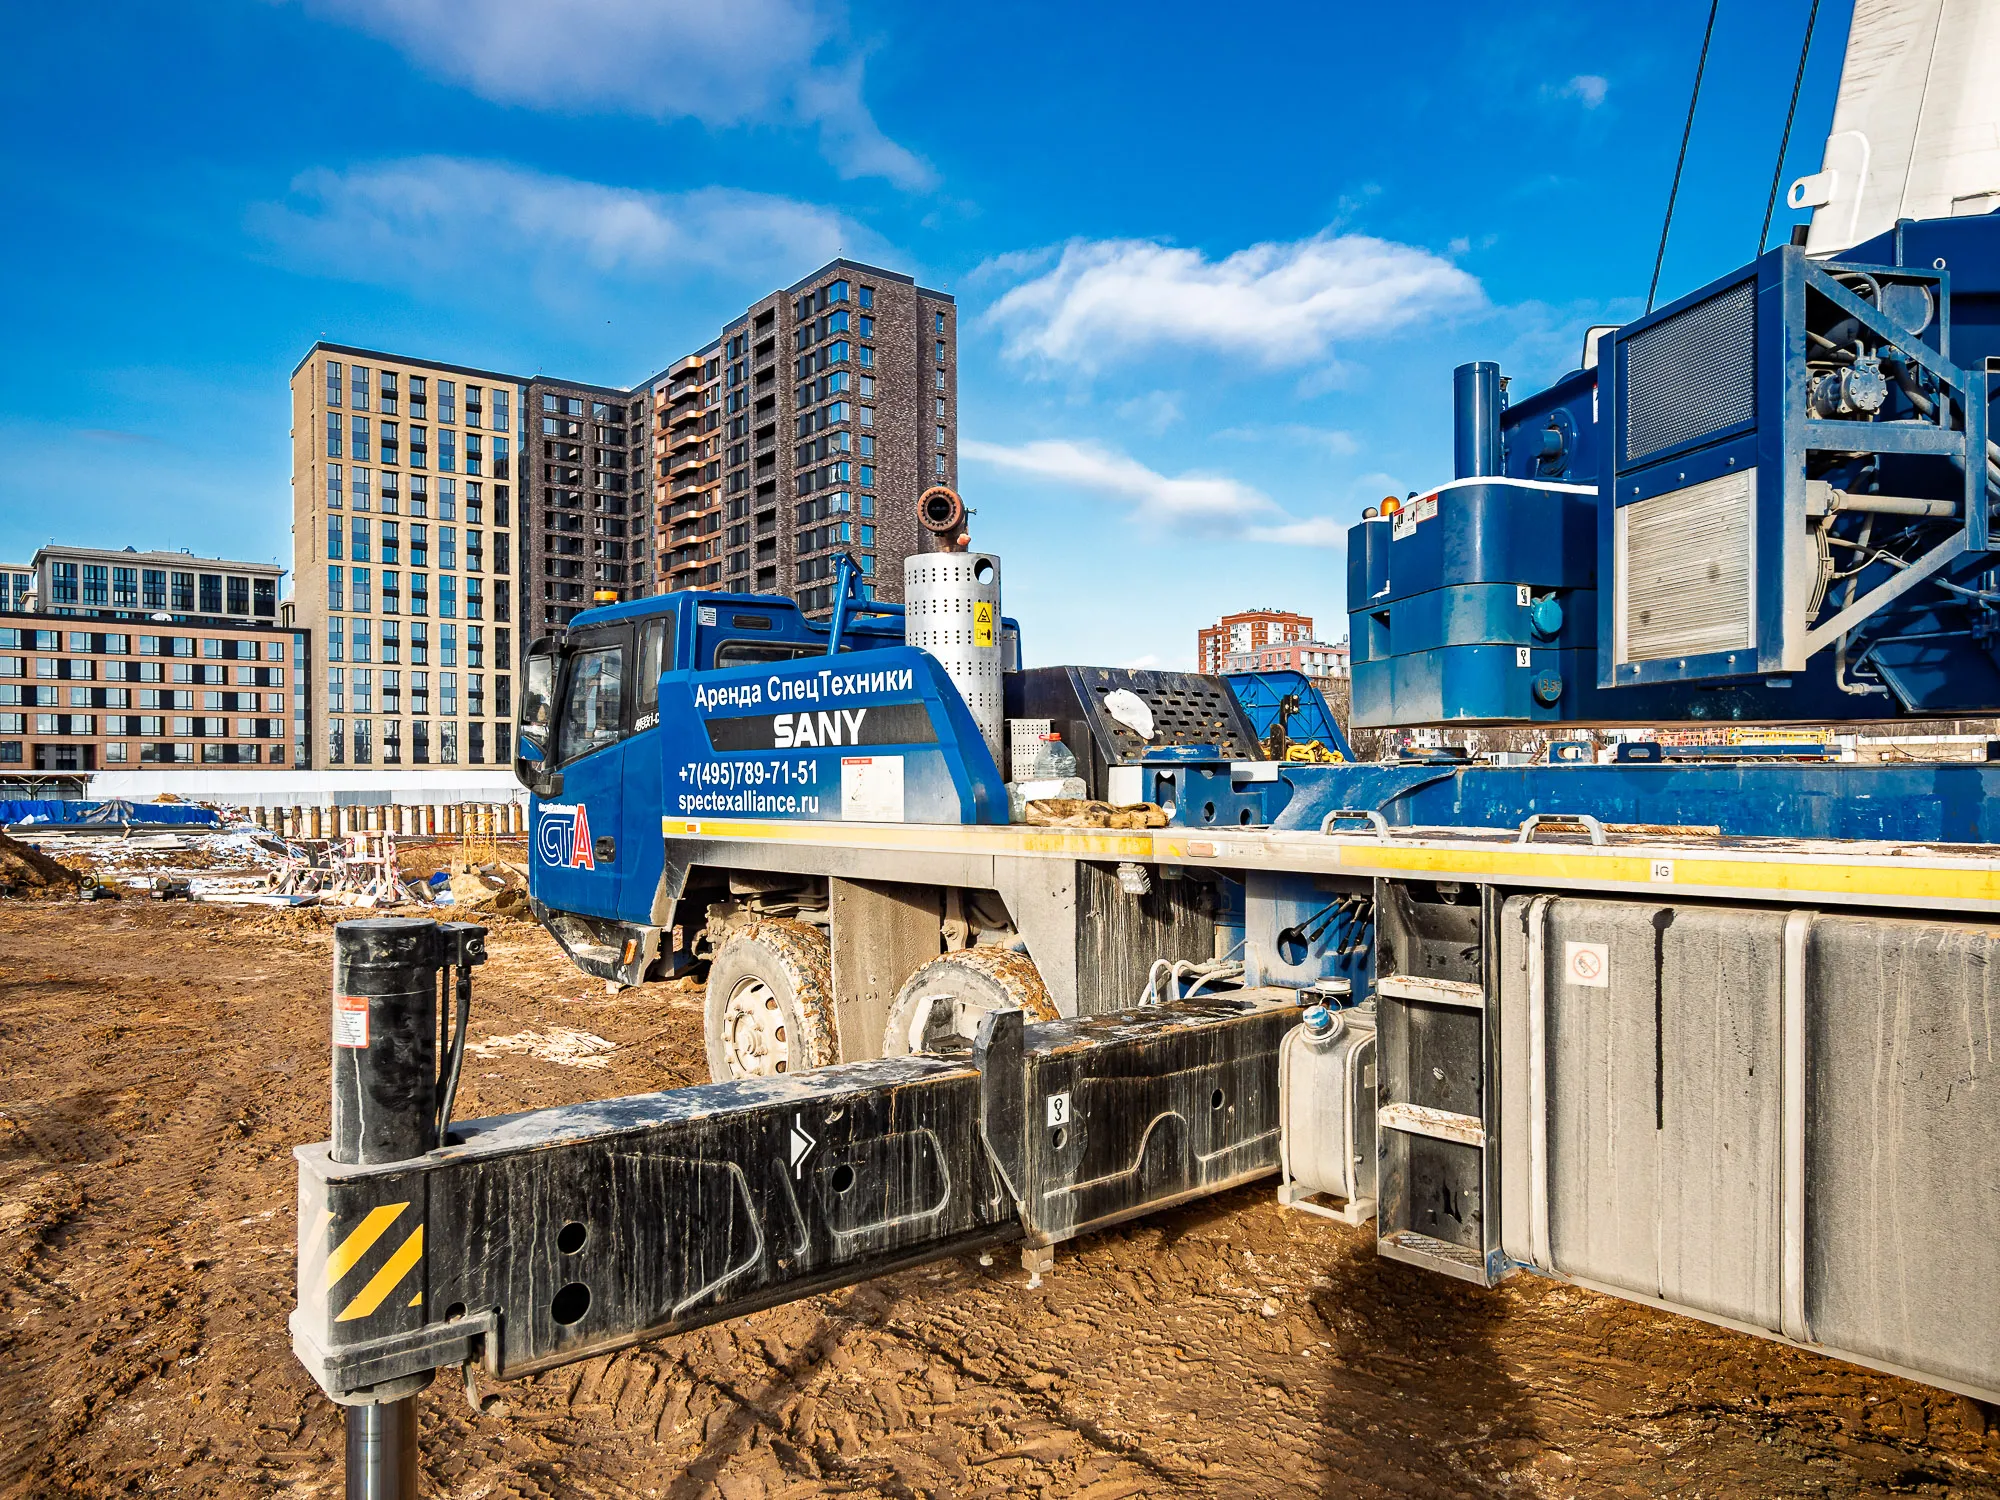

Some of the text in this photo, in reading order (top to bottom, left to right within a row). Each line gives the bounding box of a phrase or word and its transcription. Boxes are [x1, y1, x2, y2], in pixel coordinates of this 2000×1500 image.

[694, 669, 913, 712] Аренда СпецТехники
[773, 708, 867, 748] SANY
[678, 760, 818, 791] +7(495)789-71-51
[678, 790, 819, 815] spectexalliance.ru
